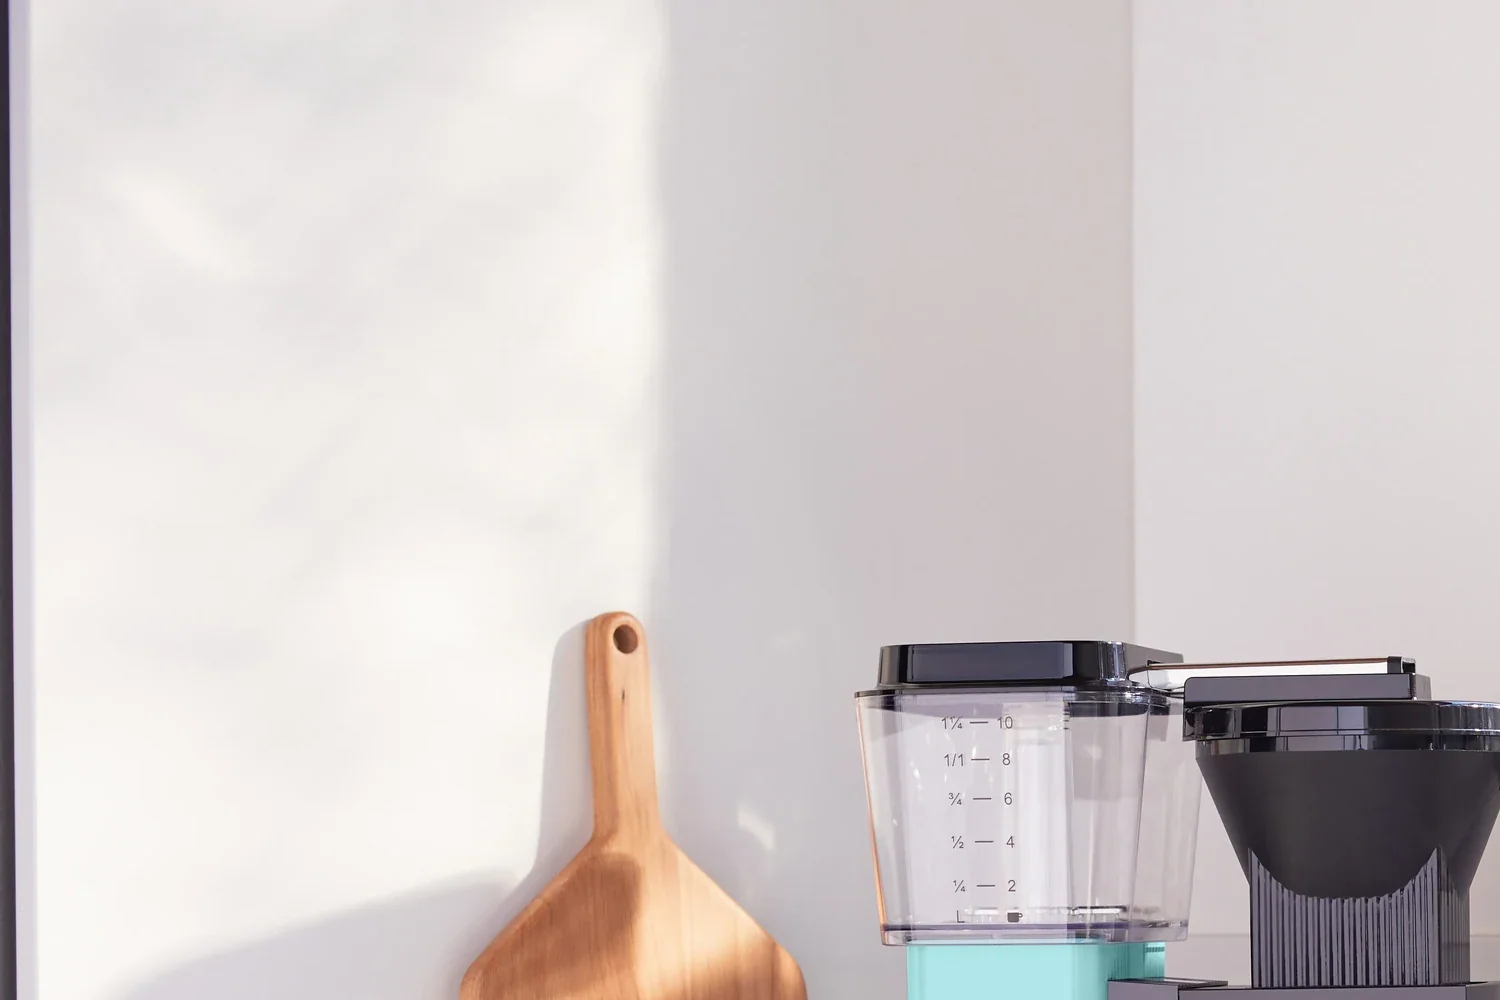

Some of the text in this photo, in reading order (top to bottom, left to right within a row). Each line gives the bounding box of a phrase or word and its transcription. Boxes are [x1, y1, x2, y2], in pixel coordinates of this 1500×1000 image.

[998, 716, 1013, 729] 10
[944, 753, 1011, 767] 1/1 8
[949, 793, 1013, 806] ¾ 6
[951, 836, 1015, 849] ½ 4
[953, 880, 1016, 893] ¼ 2
[956, 910, 965, 923] L
